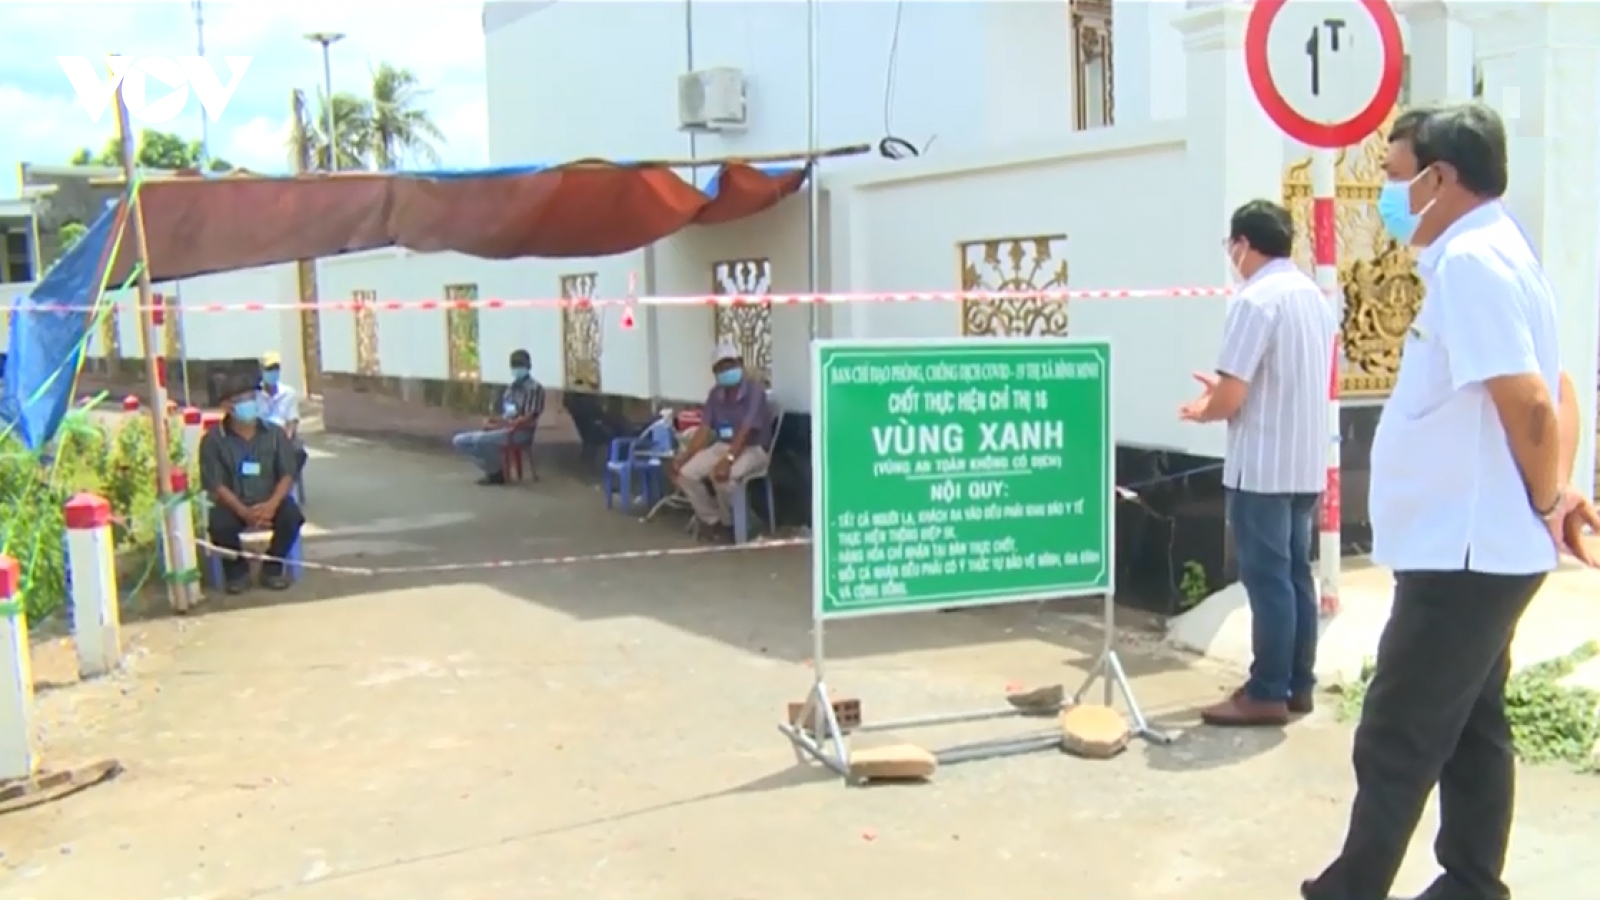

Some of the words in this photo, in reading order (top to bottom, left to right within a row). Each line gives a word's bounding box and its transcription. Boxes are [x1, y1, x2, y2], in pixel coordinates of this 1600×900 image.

[888, 386, 919, 414] CHỐT
[923, 389, 955, 416] THỰC
[957, 387, 986, 415] HIỆN
[989, 383, 1009, 411] CHỈ
[1012, 389, 1031, 413] THỊ
[1034, 389, 1048, 410] 16
[871, 417, 964, 456] VÙNG
[977, 420, 1063, 452] XANH
[914, 459, 931, 473] AN
[969, 454, 1009, 471] KHÔNG
[1012, 453, 1028, 469] CÓ
[930, 479, 961, 503] NỘI
